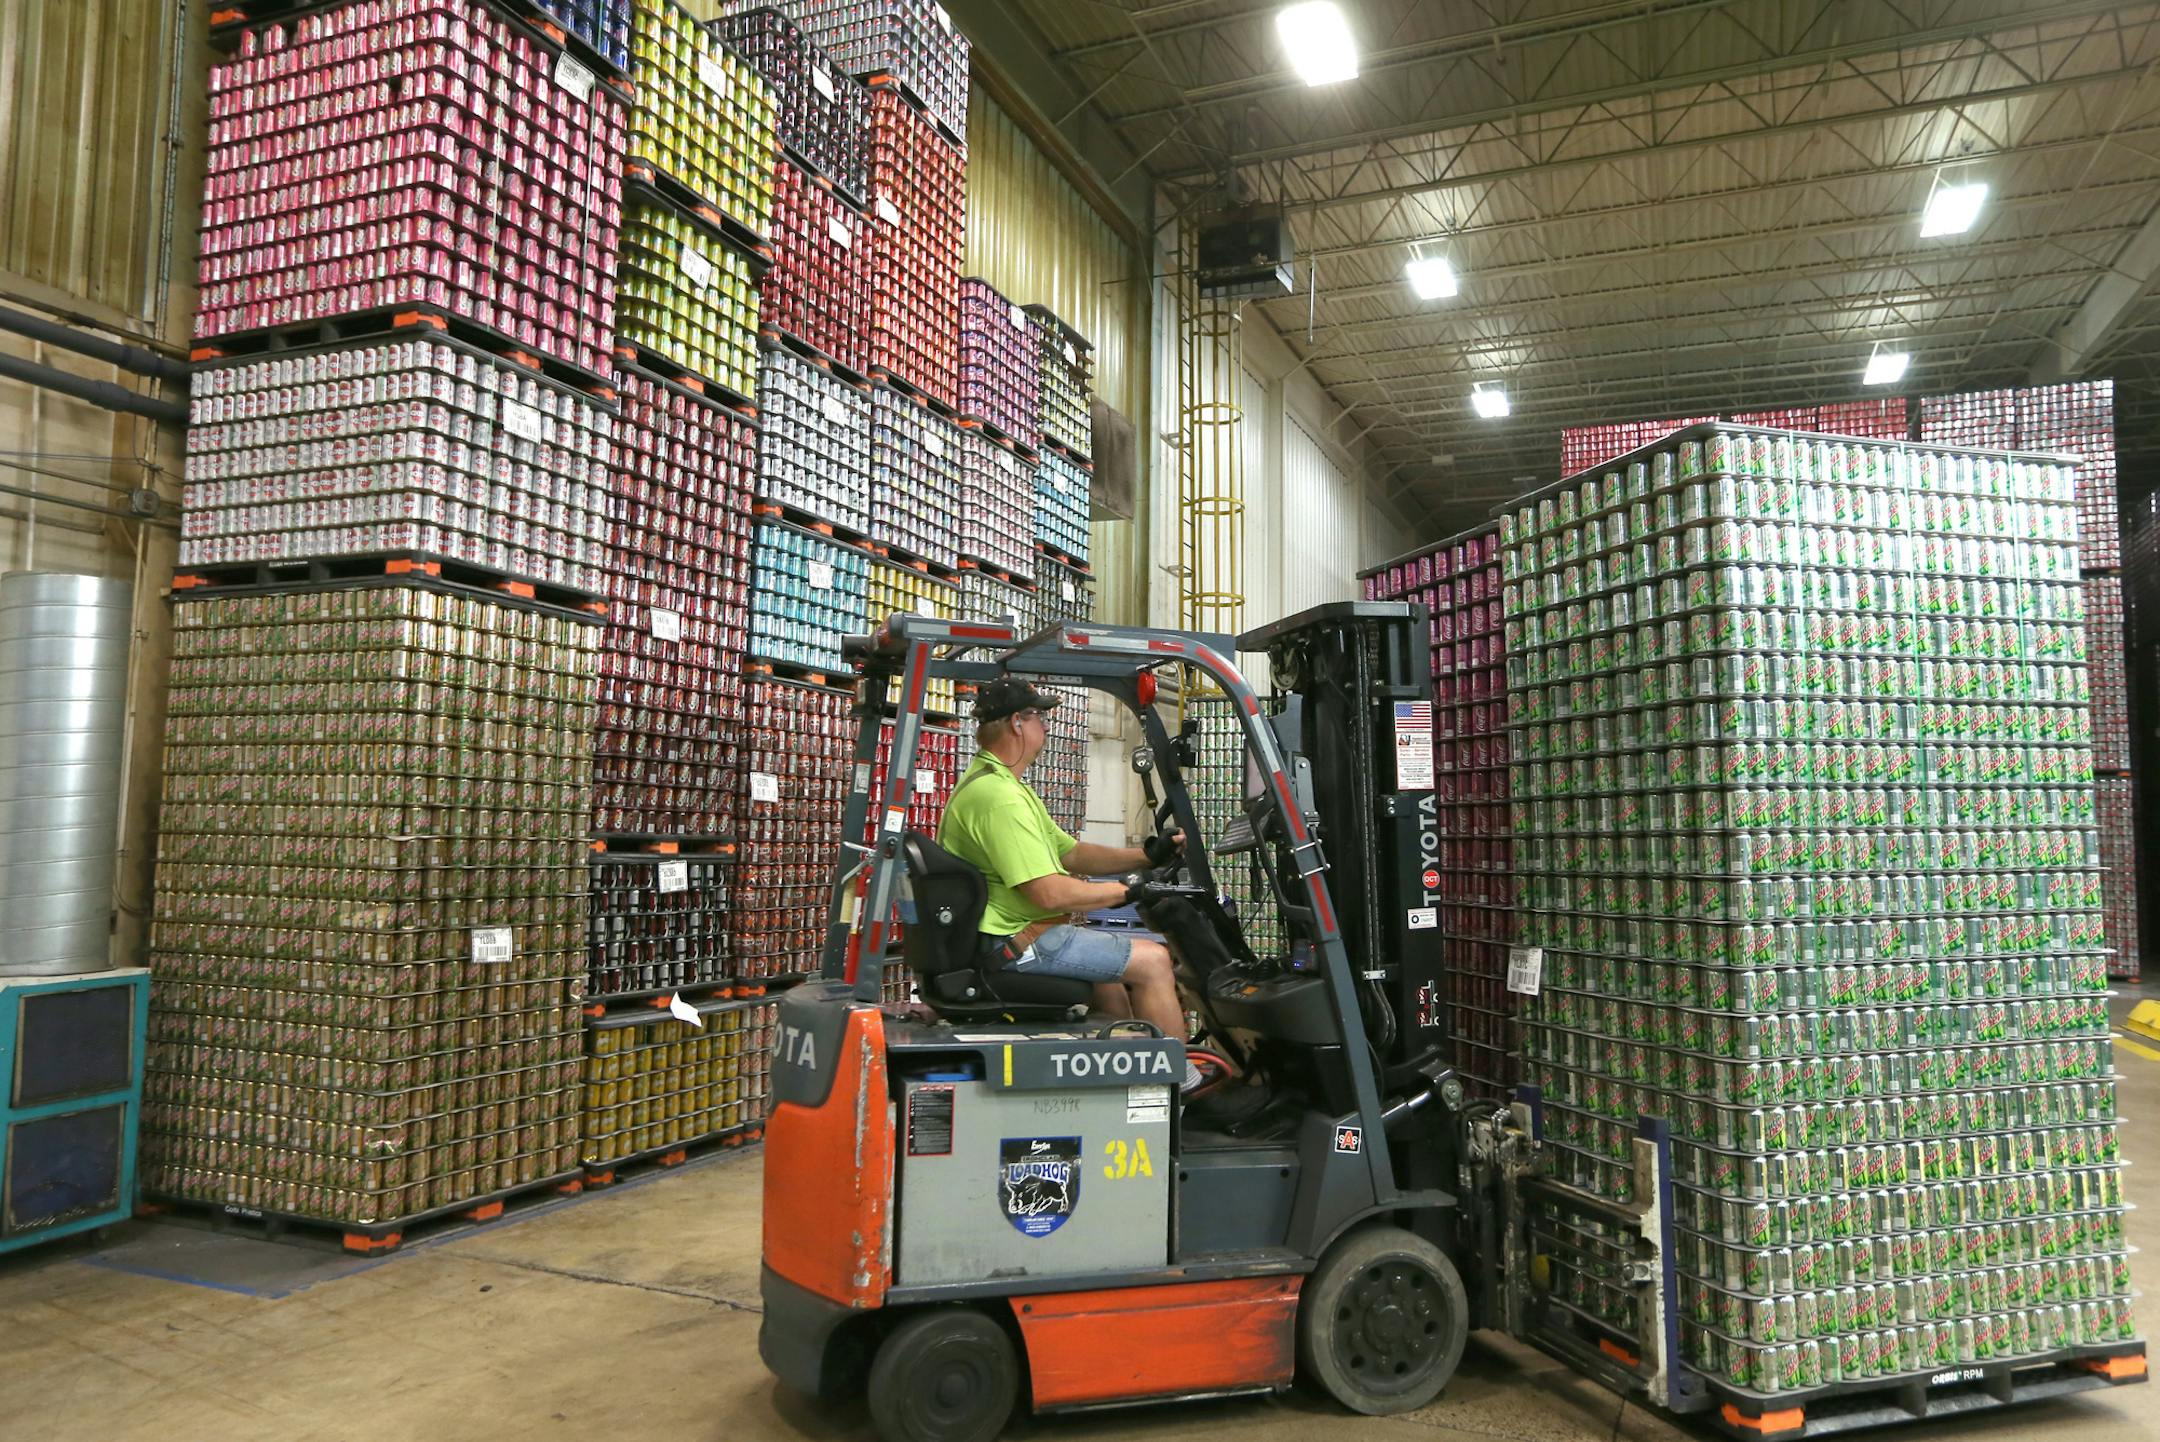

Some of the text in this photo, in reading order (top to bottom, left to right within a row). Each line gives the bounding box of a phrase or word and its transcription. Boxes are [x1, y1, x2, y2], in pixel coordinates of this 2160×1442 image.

[1418, 794, 1441, 907] TYOTA
[1424, 874, 1439, 883] OCT
[1050, 1051, 1172, 1077] TOYOTA
[1104, 1138, 1153, 1179] 3A
[1008, 1161, 1071, 1184] LOADHOG
[1963, 1368, 1984, 1380] RPM
